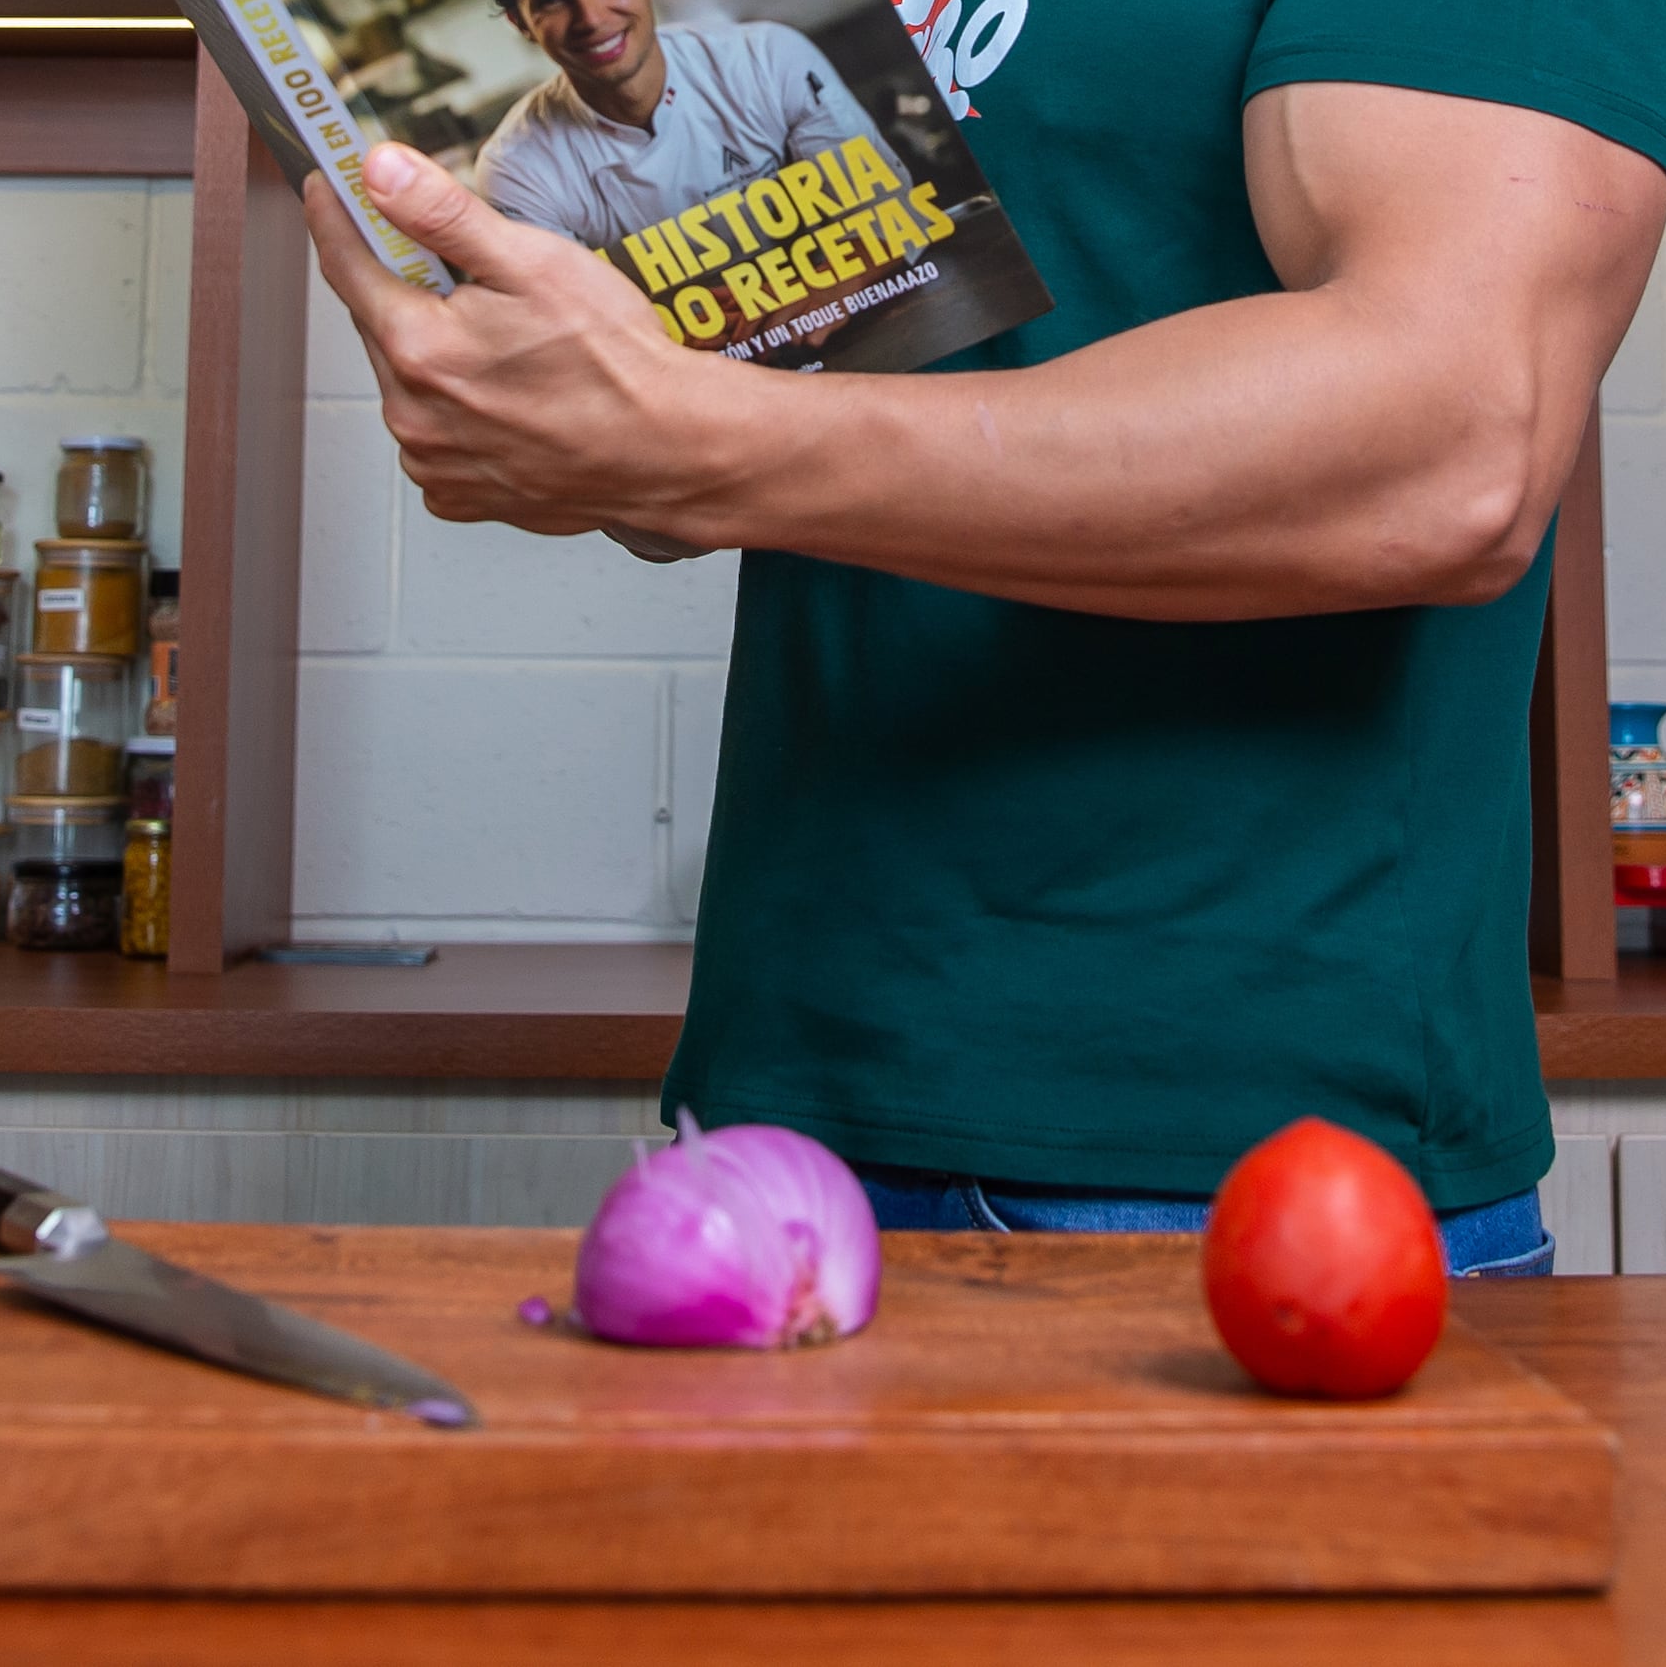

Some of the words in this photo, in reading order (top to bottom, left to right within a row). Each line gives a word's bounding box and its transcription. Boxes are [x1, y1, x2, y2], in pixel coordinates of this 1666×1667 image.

[318, 121, 354, 152] EN
[622, 135, 902, 295] HISTORIA
[721, 181, 955, 322] RECETAS
[749, 334, 765, 353] Y
[764, 323, 792, 348] UN
[788, 300, 846, 336] TOQUE
[842, 260, 940, 315] BUENAAAZO
